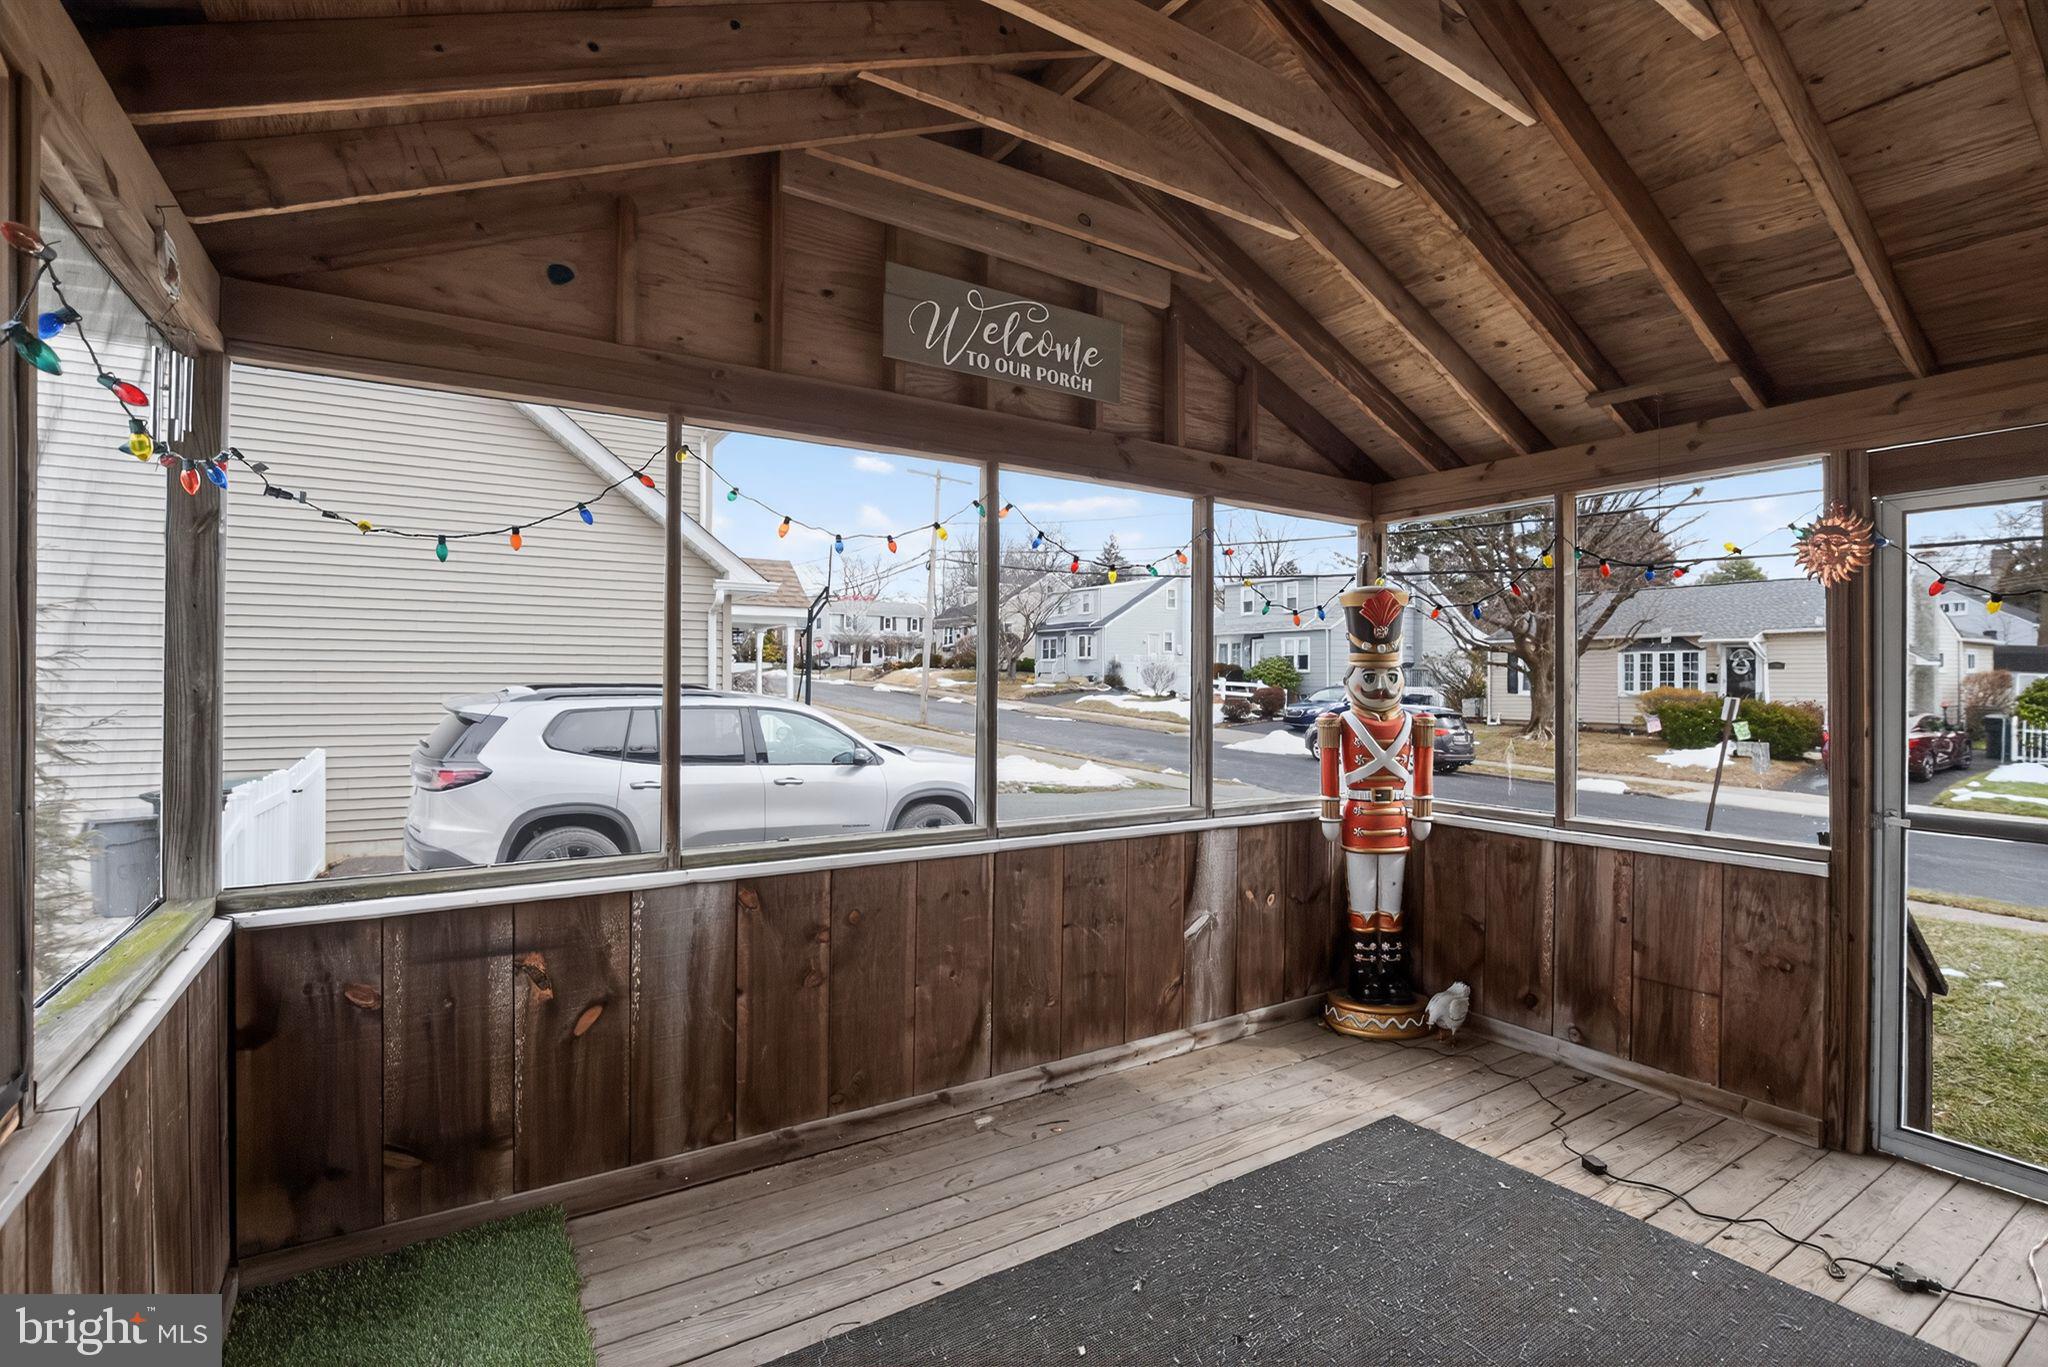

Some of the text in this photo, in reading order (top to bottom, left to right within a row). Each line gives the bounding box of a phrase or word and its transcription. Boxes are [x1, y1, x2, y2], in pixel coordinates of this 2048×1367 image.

[908, 289, 1103, 375] Welcome
[966, 350, 1093, 393] TO OUR PORCH
